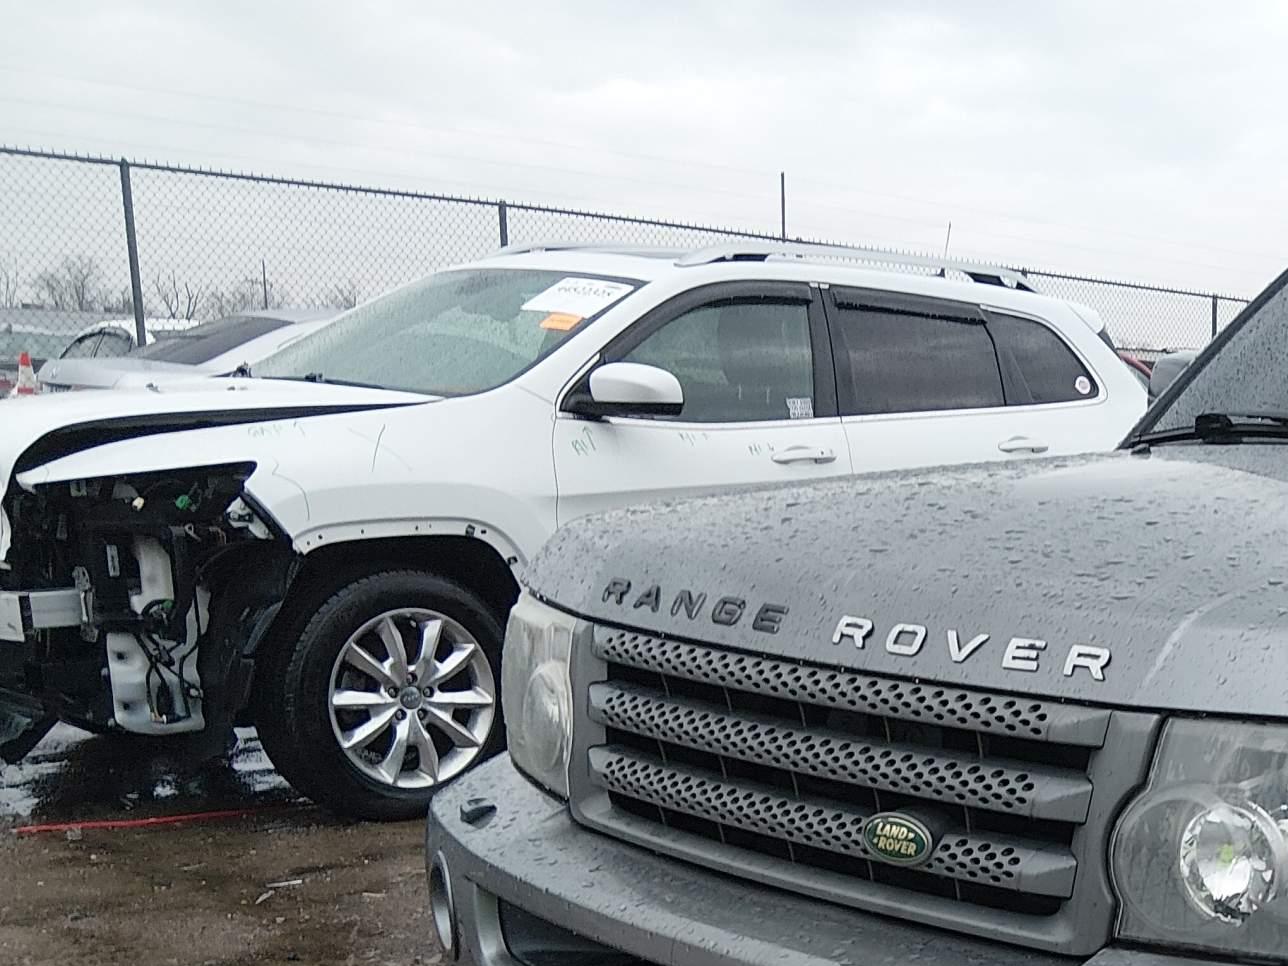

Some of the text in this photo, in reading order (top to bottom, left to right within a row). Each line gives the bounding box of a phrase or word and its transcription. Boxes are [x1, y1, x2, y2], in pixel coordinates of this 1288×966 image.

[601, 576, 1112, 683] RANGE ROVER
[876, 822, 908, 840] LAND
[877, 836, 917, 856] ROVER
